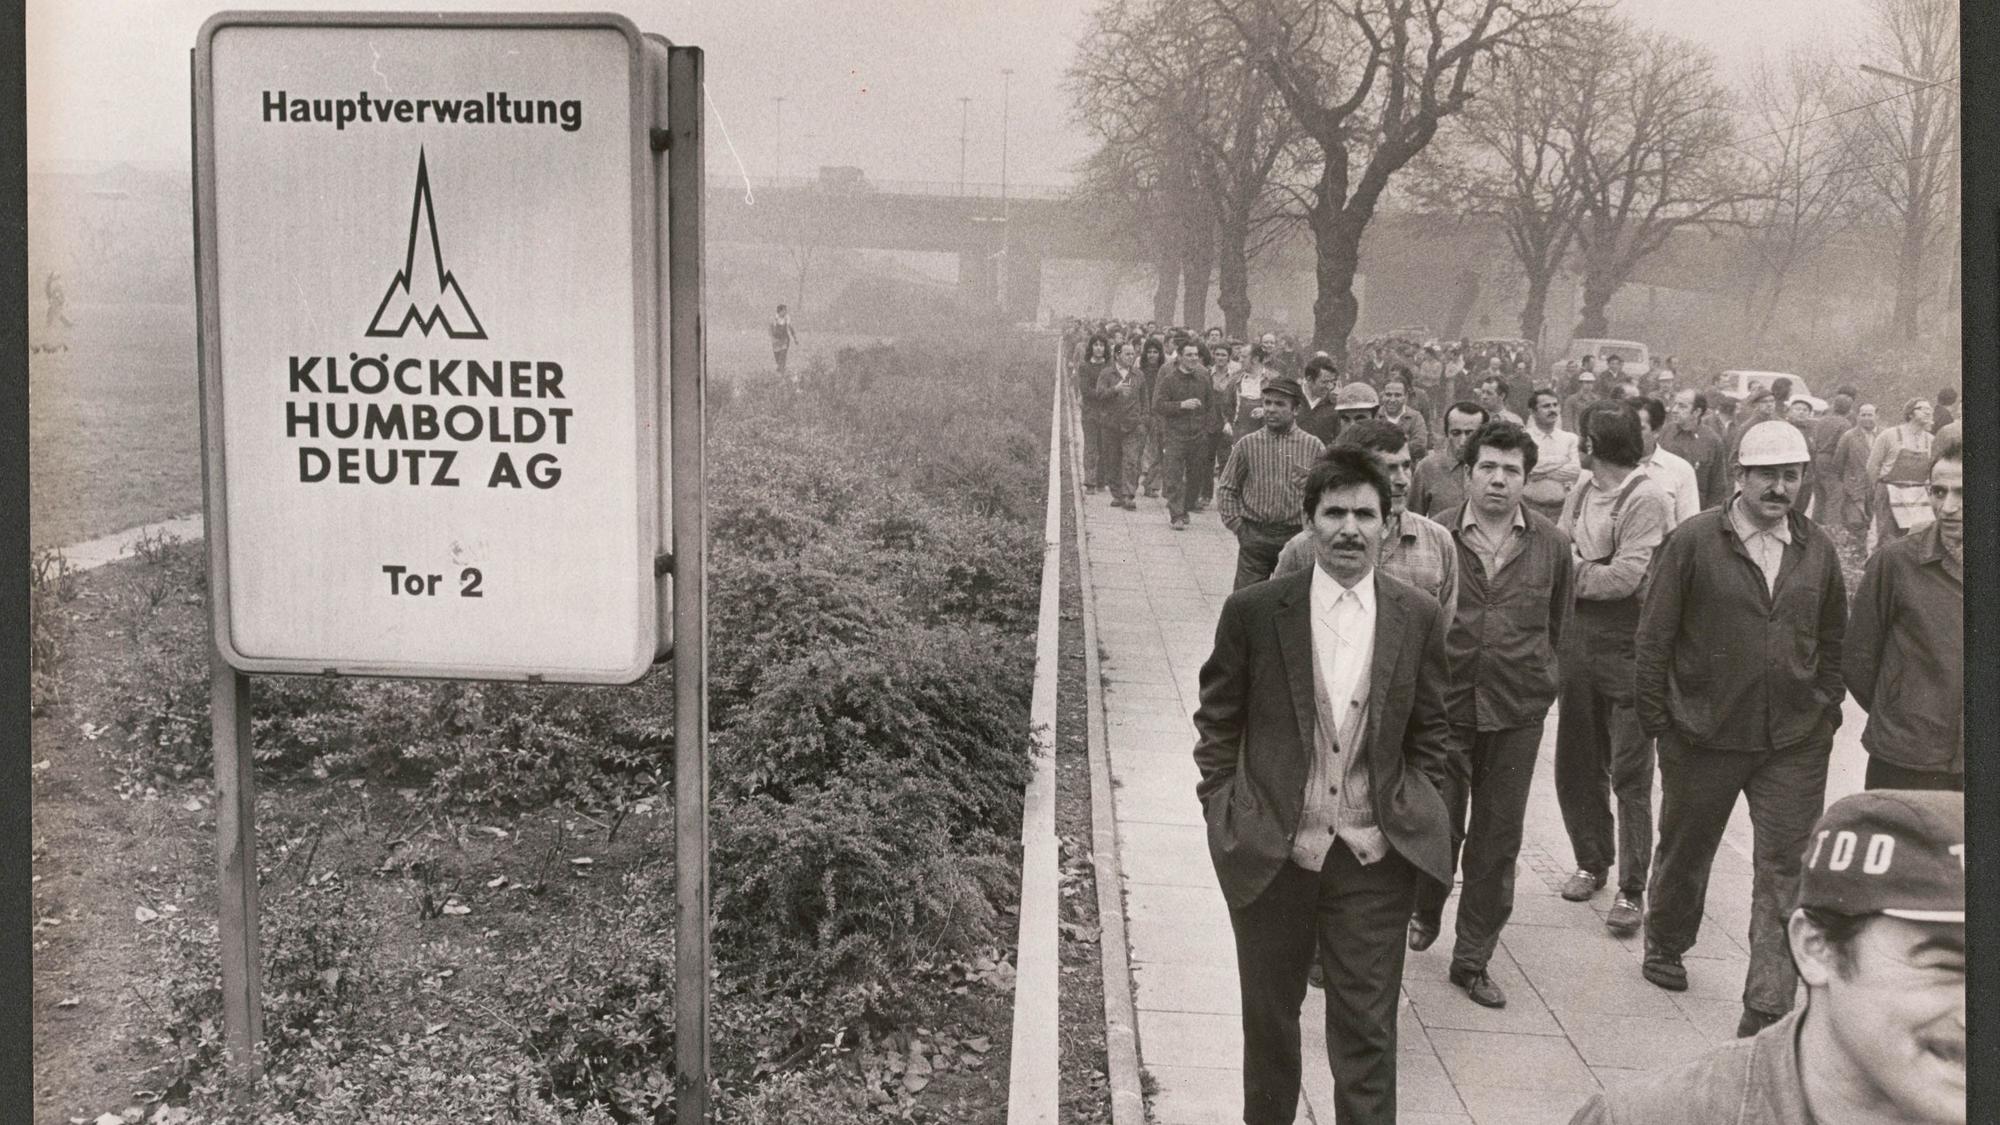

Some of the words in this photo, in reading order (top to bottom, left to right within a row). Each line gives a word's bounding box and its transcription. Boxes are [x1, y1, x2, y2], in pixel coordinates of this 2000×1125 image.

[263, 91, 582, 132] Hauptverwaltung
[290, 353, 565, 399] KLÖCKNER
[287, 402, 573, 444] HUMBOLDT
[300, 448, 460, 487] DEUTZ
[489, 453, 562, 489] AG
[383, 566, 442, 596] Tor
[461, 568, 483, 598] 2
